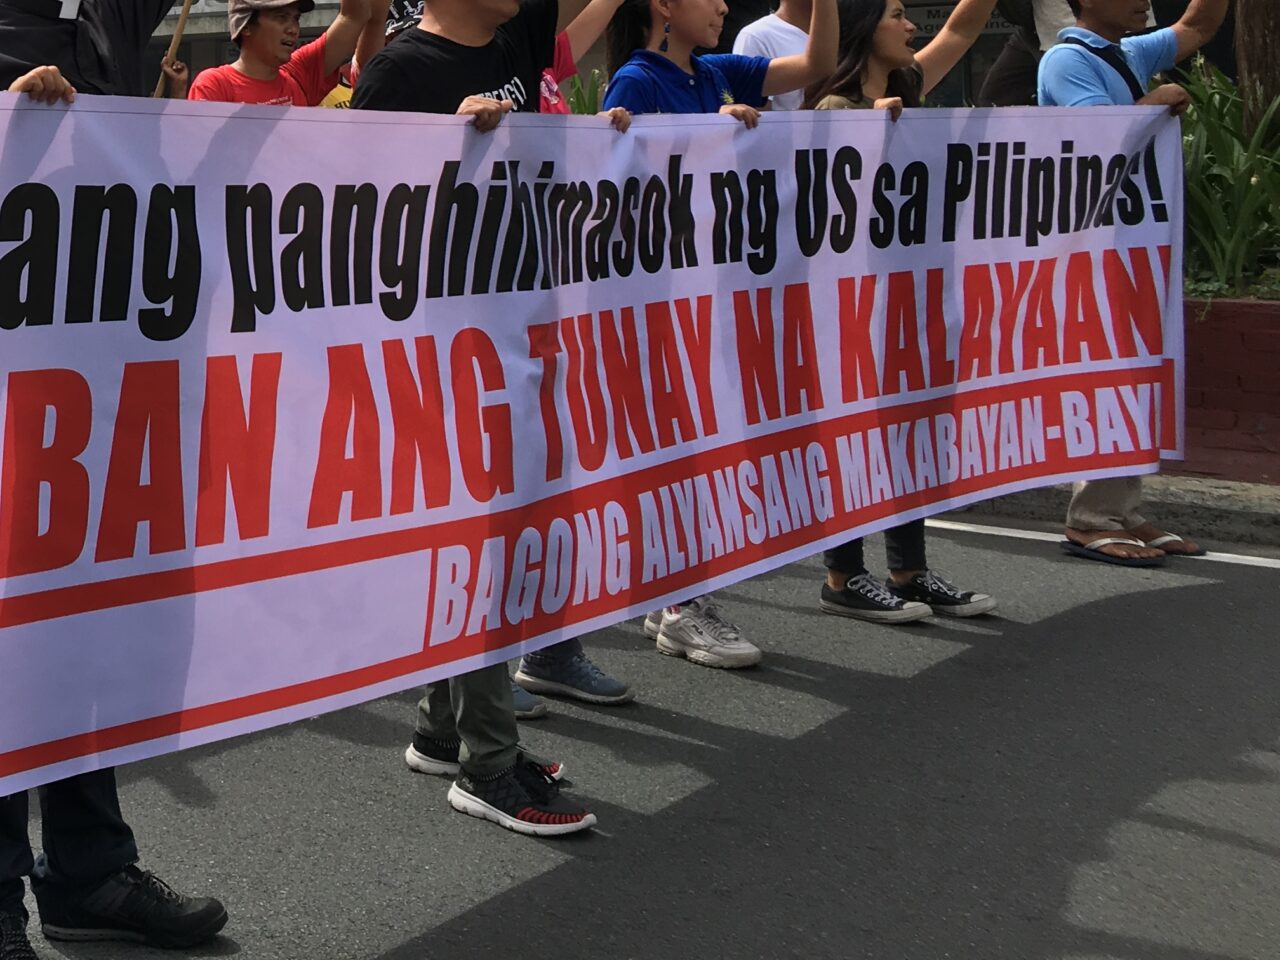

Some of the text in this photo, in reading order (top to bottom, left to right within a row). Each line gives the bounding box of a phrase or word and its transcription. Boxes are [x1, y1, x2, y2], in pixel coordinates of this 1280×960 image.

[712, 168, 778, 276] ng
[794, 145, 863, 258] US
[869, 160, 930, 250] sa
[942, 134, 1169, 247] Pilipinas!
[306, 327, 515, 530] ANG
[527, 294, 719, 482] TUNAY
[732, 281, 824, 426] NA
[429, 498, 630, 648] BAGONG
[637, 439, 836, 585] ALYANSANG
